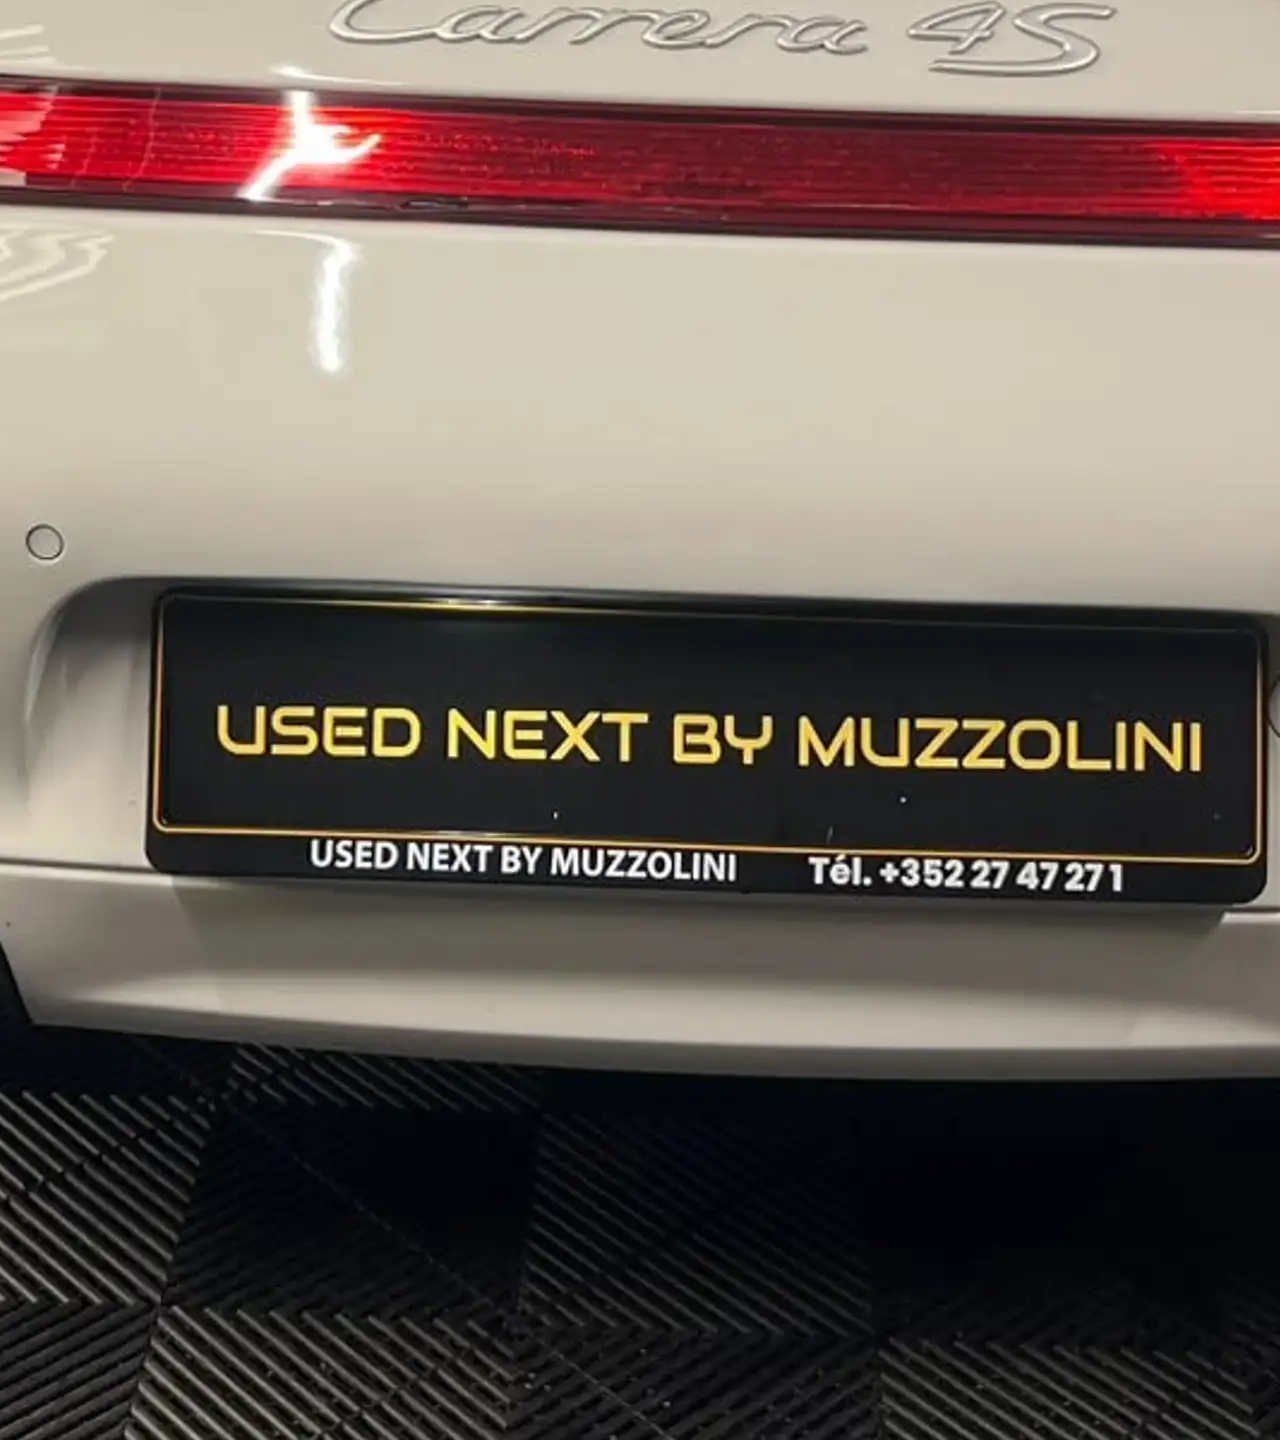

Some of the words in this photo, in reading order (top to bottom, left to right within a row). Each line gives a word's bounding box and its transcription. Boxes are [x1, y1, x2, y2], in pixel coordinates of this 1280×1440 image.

[906, 0, 1117, 76] 4S
[216, 705, 422, 759] USED
[446, 710, 648, 764] NEXT
[673, 715, 774, 767] BY
[797, 716, 1203, 774] MUZZOLINI
[310, 839, 398, 870] USED
[407, 843, 493, 873] NEXT
[501, 846, 543, 875] BY
[550, 848, 738, 882] MUZZOLINI
[808, 853, 872, 886] Tél.
[879, 857, 965, 889] +352
[970, 859, 1010, 890] 27
[1016, 861, 1059, 891] 47
[1064, 863, 1124, 892] 271
